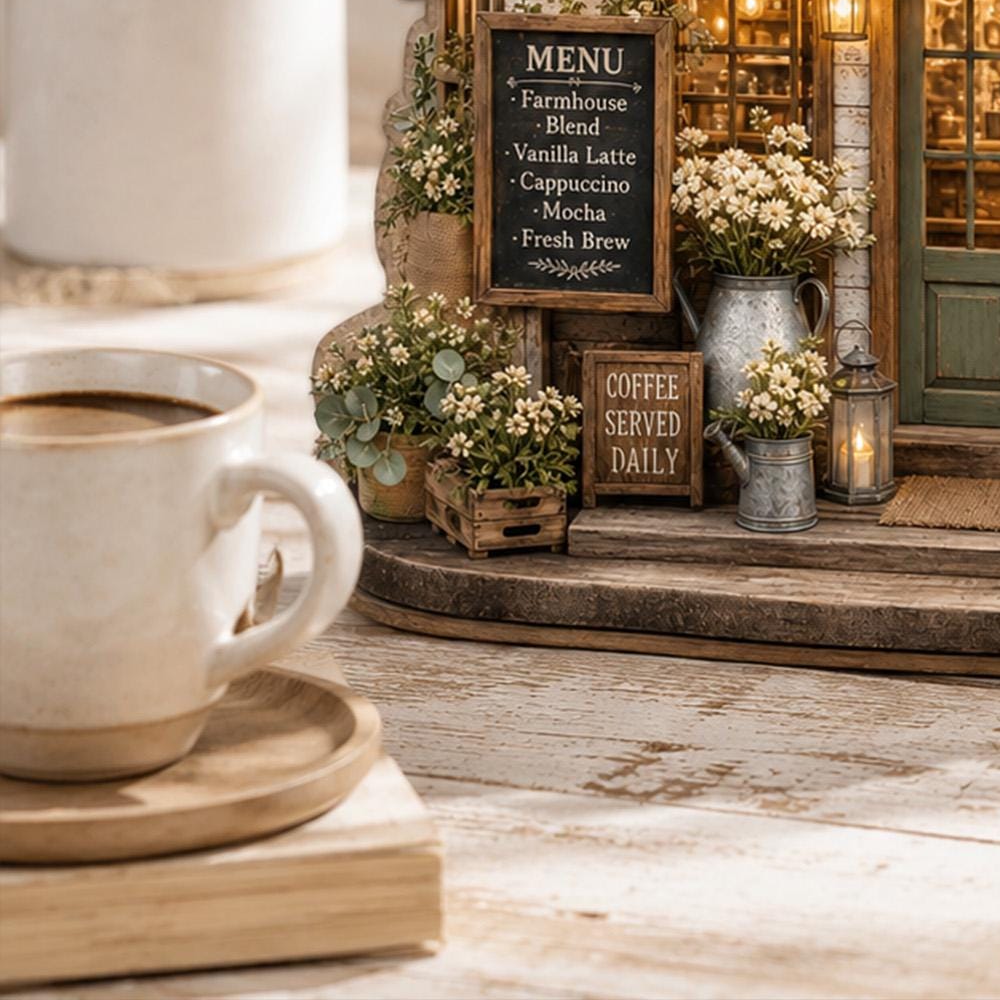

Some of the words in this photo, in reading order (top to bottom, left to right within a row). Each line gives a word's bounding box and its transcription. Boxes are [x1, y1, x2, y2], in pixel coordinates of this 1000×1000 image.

[526, 44, 624, 75] MENU
[521, 90, 628, 112] Farmhouse
[546, 115, 600, 136] Blend
[513, 142, 579, 164] Vanilla
[586, 146, 636, 166] Latte
[520, 171, 630, 196] Cappuccino
[542, 201, 606, 222] Mocha
[522, 228, 574, 249] Fresh
[582, 230, 630, 250] Brew
[607, 372, 679, 400] COFFEE
[605, 410, 681, 437] SERVED
[612, 446, 679, 474] DAILY
